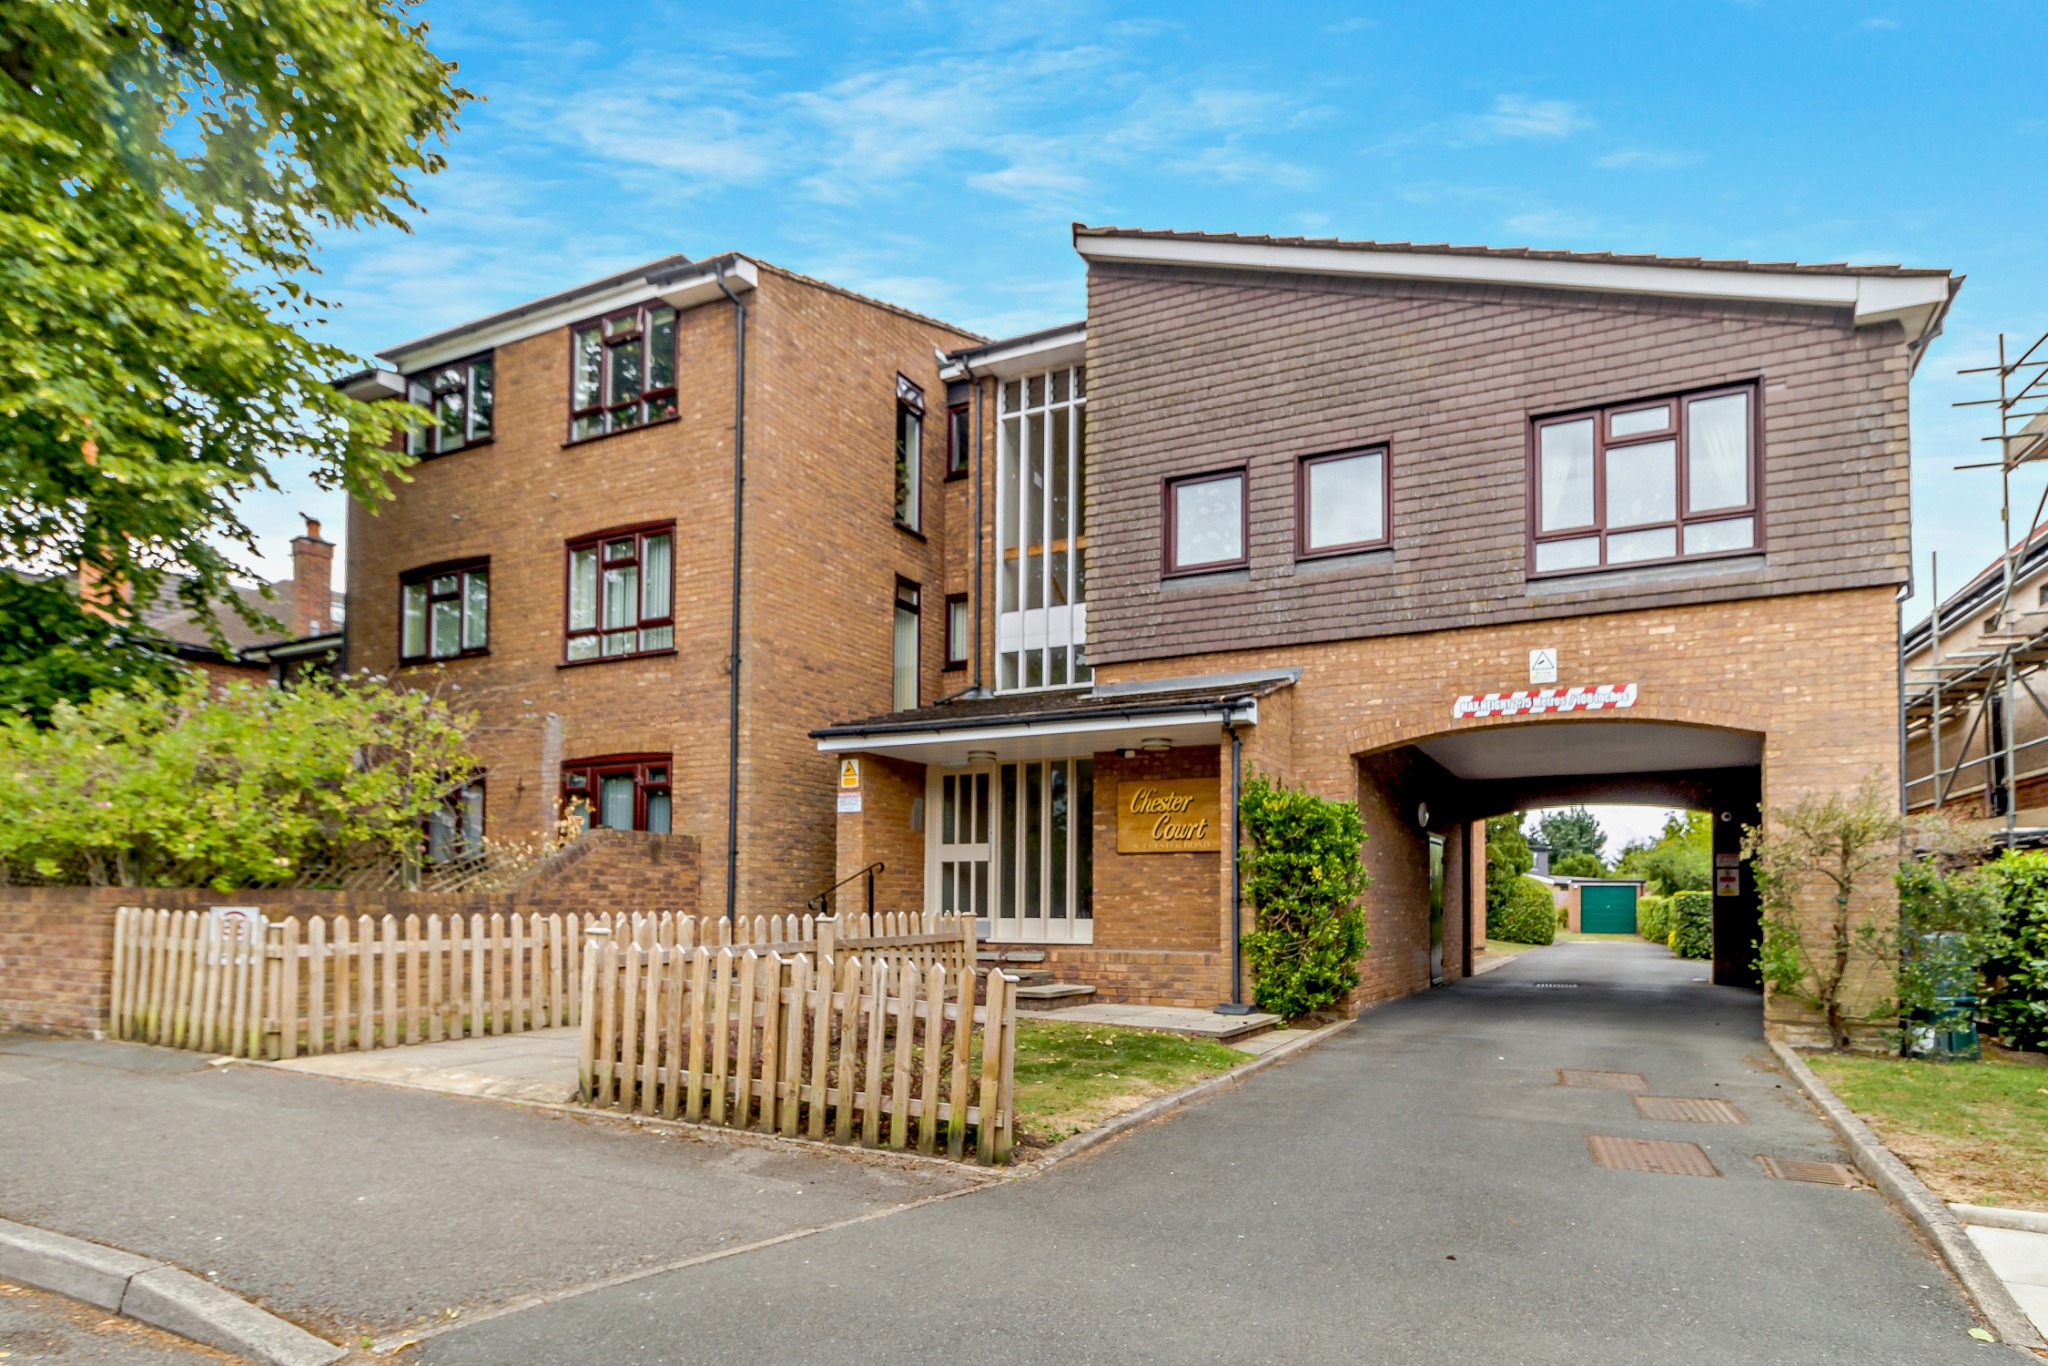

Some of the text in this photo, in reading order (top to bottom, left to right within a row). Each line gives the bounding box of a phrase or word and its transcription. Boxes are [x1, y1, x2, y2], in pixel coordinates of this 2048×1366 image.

[1533, 694, 1566, 708] Metres
[1130, 787, 1193, 814] Chester
[1152, 814, 1208, 841] Court
[1184, 841, 1211, 850] ROAD
